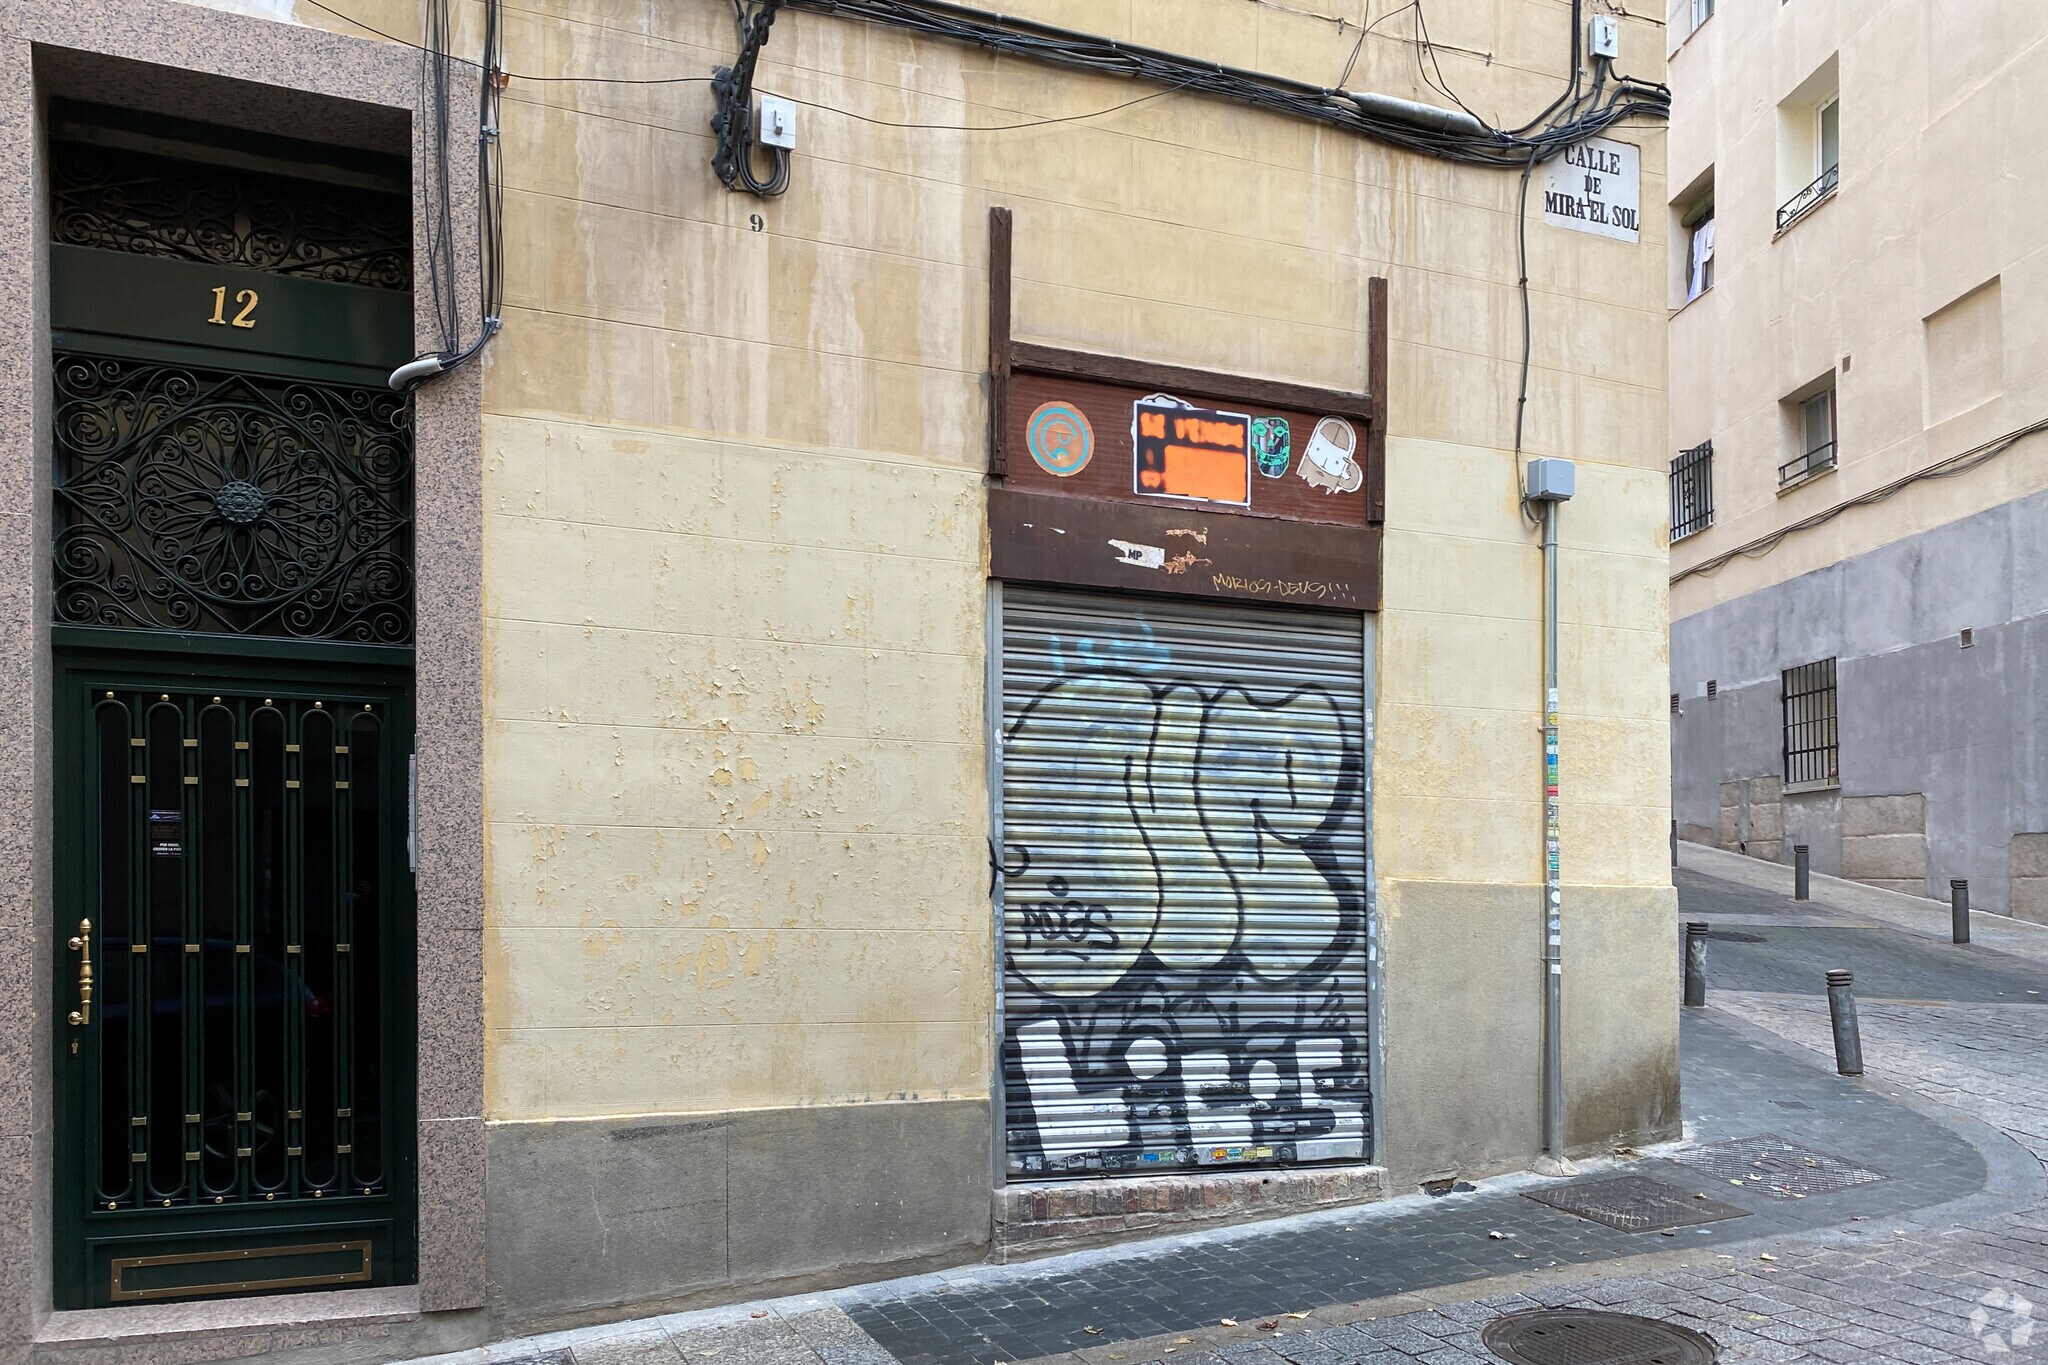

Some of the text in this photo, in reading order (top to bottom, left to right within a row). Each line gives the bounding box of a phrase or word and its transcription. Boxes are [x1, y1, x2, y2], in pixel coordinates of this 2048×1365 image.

[1565, 145, 1620, 175] CALLE
[1584, 175, 1601, 195] DE
[750, 214, 764, 232] 9
[1545, 191, 1639, 231] MIRA EL SOL
[208, 286, 258, 328] 12
